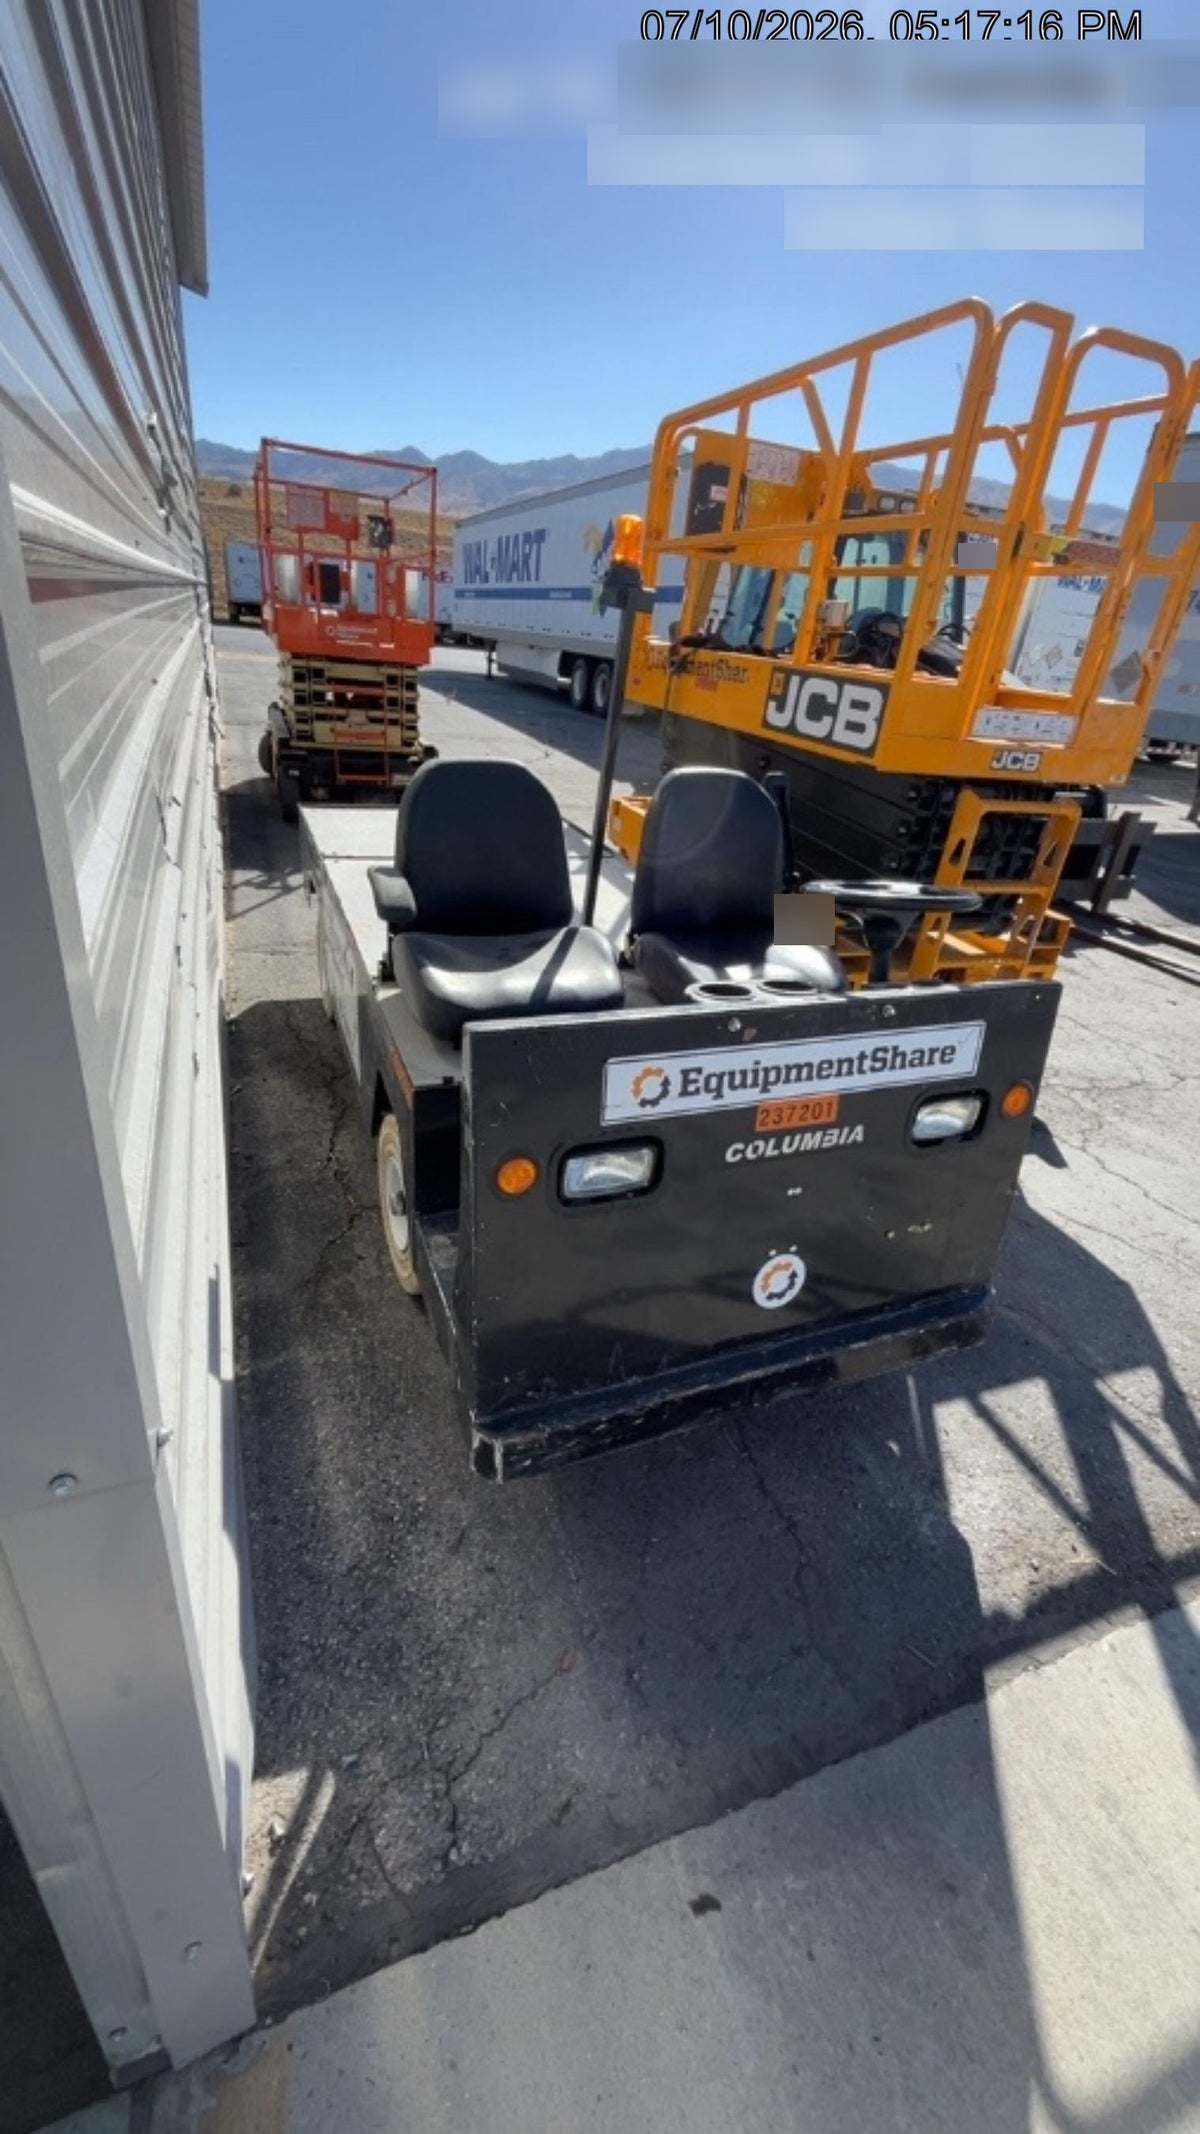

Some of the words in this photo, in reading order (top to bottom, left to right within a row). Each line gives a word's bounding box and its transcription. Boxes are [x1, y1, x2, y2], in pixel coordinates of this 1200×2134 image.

[766, 675, 883, 750] JCB
[991, 750, 1041, 772] JCB
[678, 1045, 956, 1100] EquipmentShare
[759, 1101, 834, 1128] 237201
[725, 1124, 865, 1163] COLUMBIA
